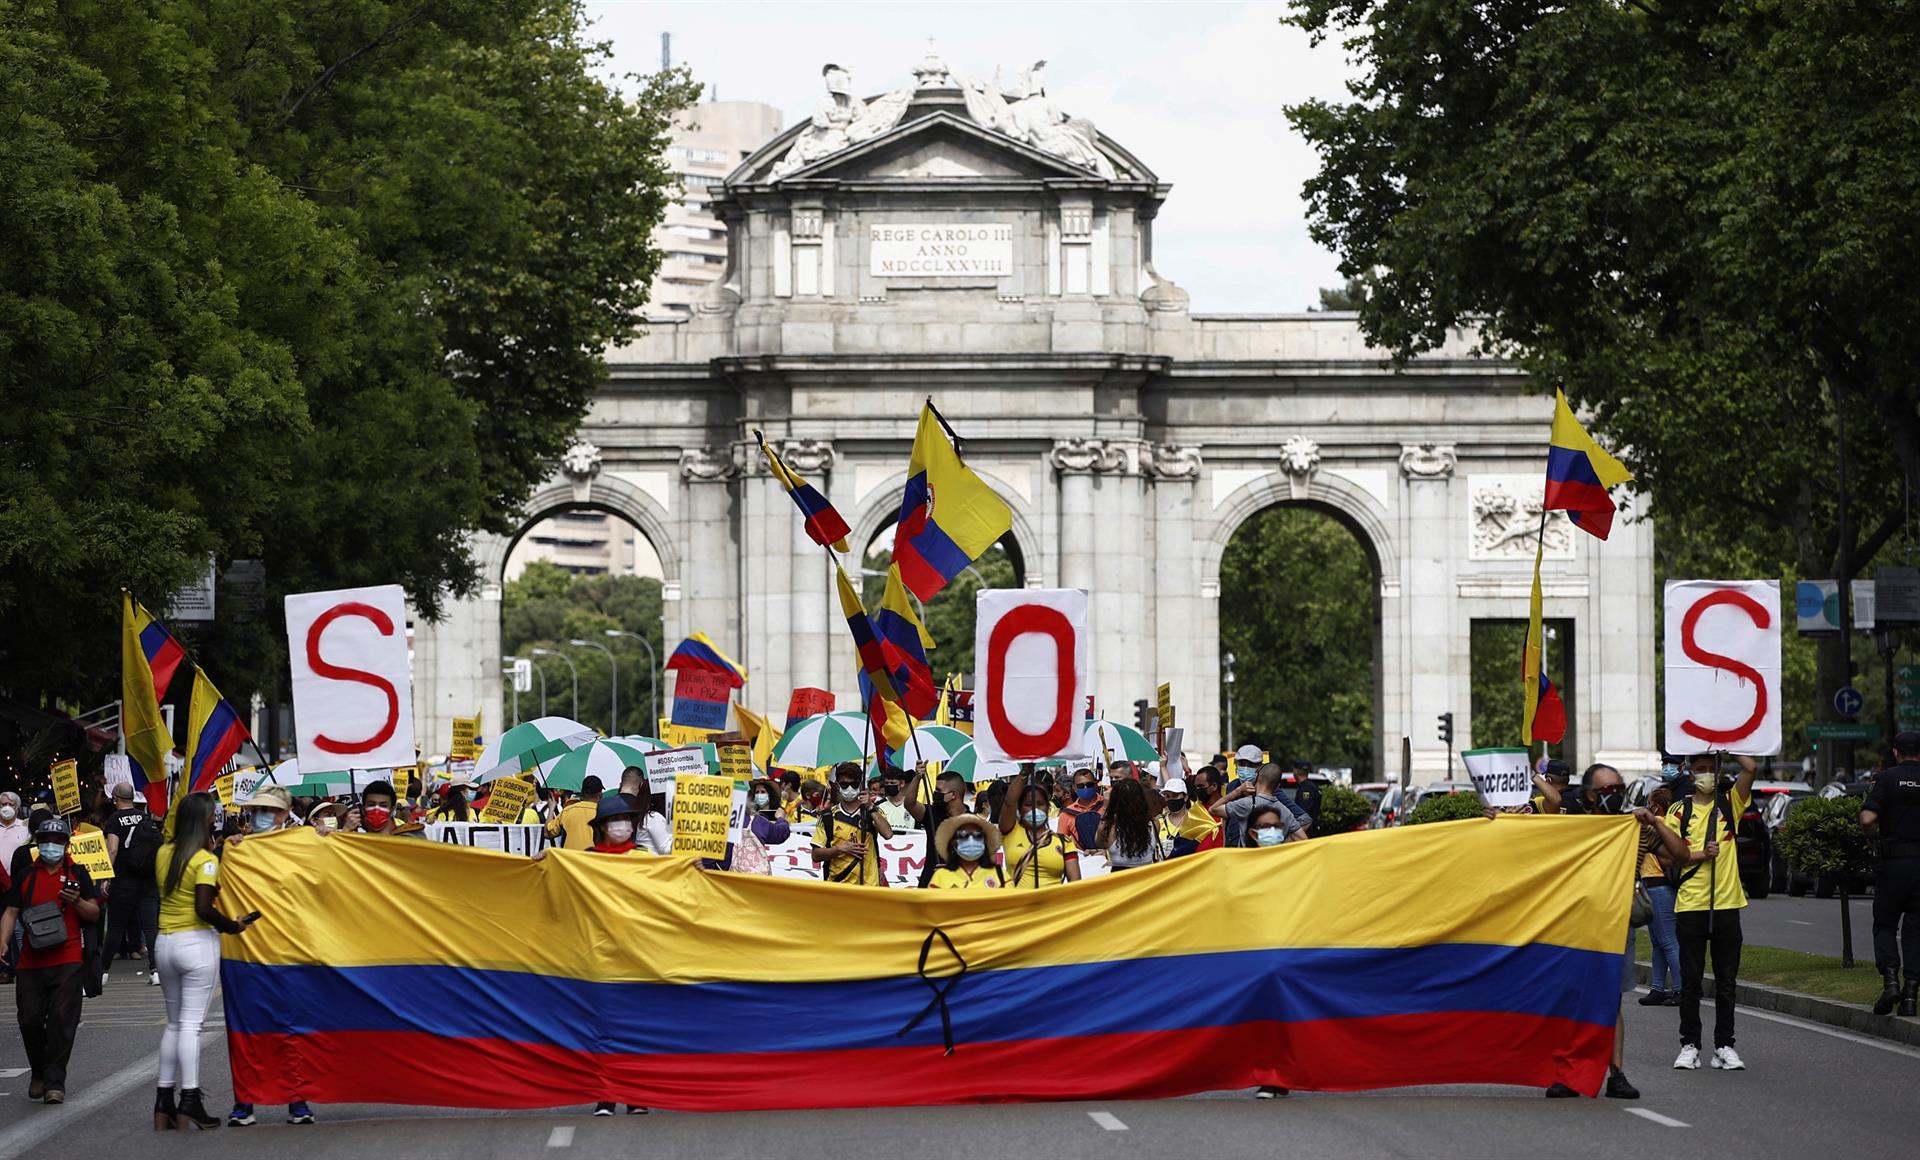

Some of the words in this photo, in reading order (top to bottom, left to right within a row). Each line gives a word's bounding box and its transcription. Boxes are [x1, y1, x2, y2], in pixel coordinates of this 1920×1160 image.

[871, 230, 915, 241] REGE
[920, 230, 988, 241] CAROLO
[994, 230, 1013, 241] III
[916, 245, 968, 256] ANNO
[881, 260, 1002, 271] MDCCLXXVIII
[1680, 589, 1771, 744] S
[306, 602, 400, 755] S
[986, 603, 1077, 760] O
[701, 687, 719, 698] PAZ
[677, 733, 688, 744] LA
[503, 780, 529, 793] GOBIERNO
[677, 782, 687, 795] EL
[688, 783, 731, 798] GOBIERNO
[493, 789, 524, 803] COLOMBIANO
[491, 799, 506, 808] ATACA
[676, 801, 729, 816] COLOMBIANO
[676, 819, 702, 832] ATACA
[703, 821, 709, 833] A
[710, 821, 726, 835] SUS
[70, 839, 104, 855] OLOMBIA
[674, 838, 725, 853] CIUDADANOS!
